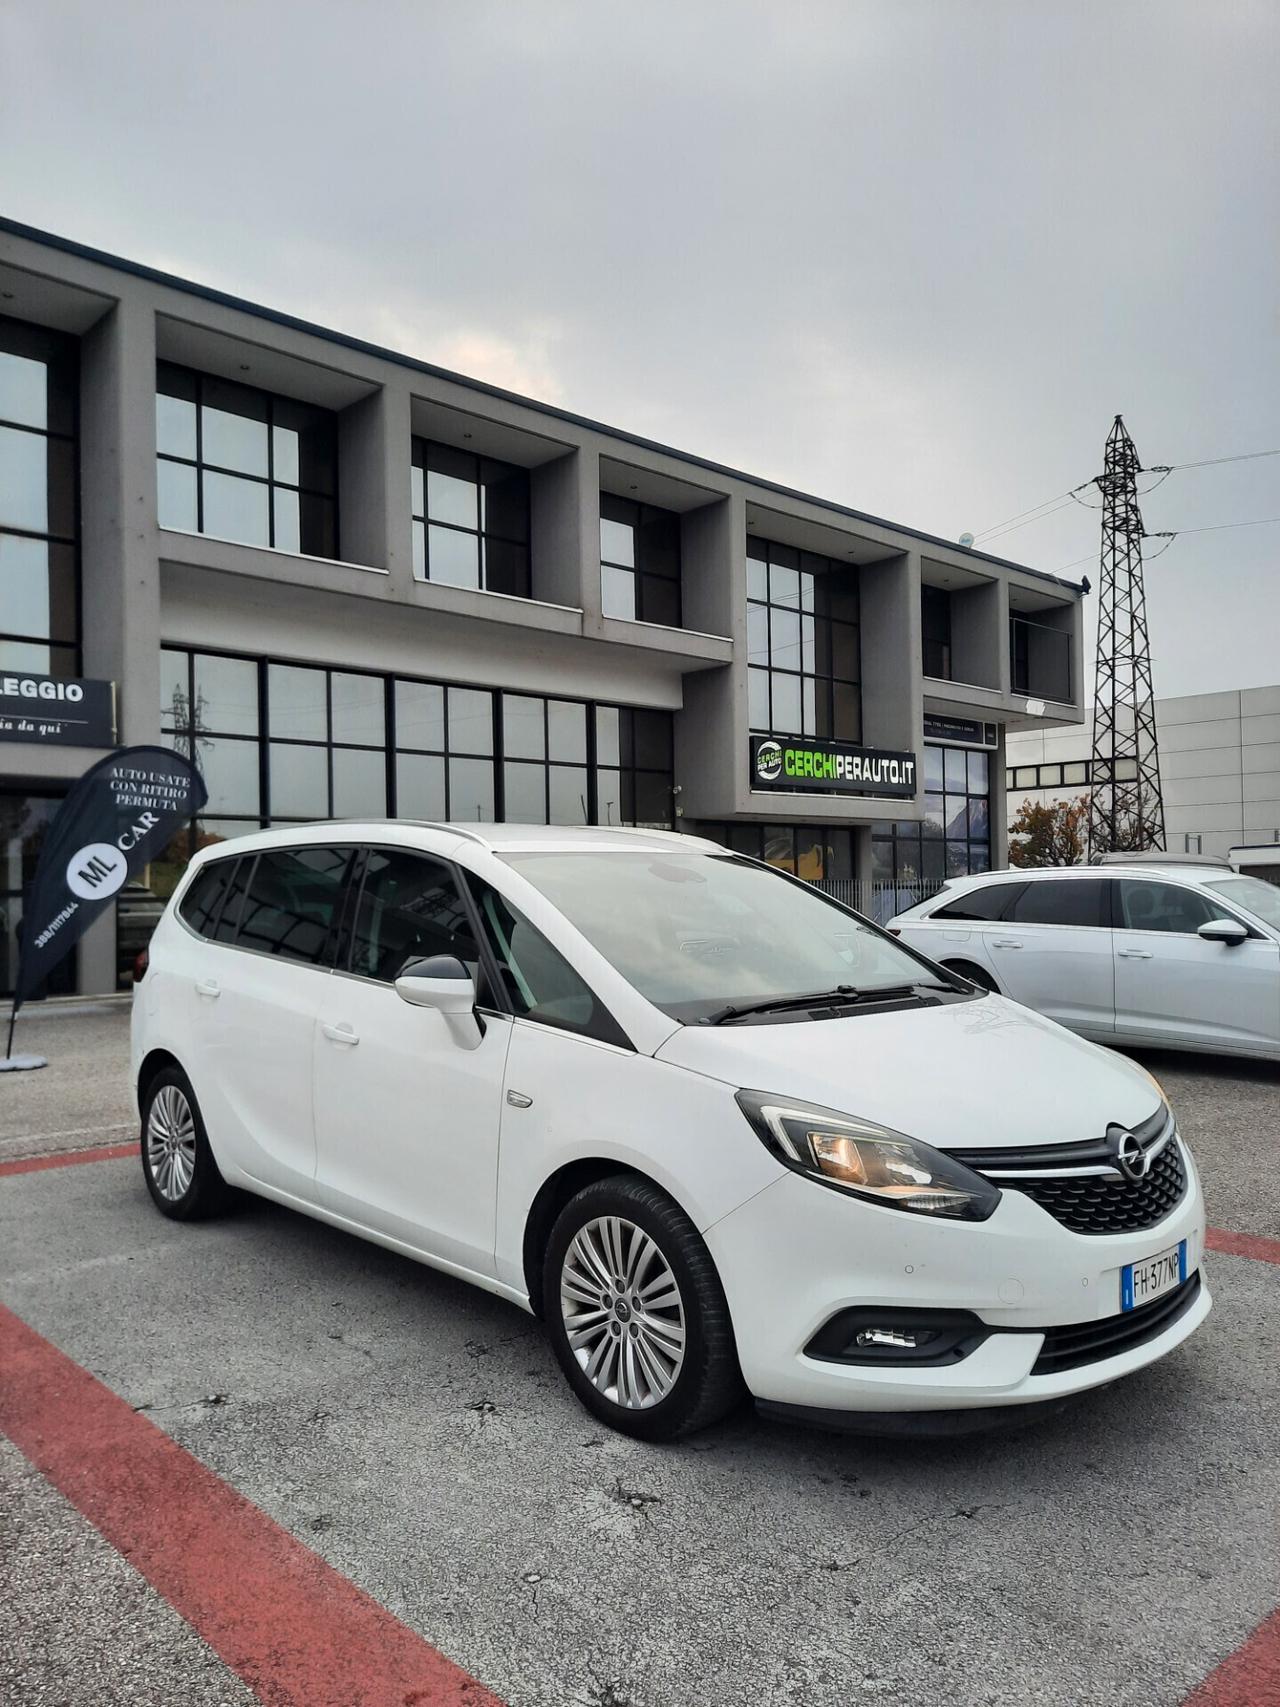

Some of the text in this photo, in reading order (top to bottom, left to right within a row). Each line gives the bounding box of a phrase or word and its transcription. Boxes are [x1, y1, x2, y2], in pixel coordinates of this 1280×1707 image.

[0, 678, 83, 702] EGGIO
[18, 720, 34, 731] da
[39, 723, 62, 736] qui
[111, 767, 191, 788] AUTO USATE
[785, 749, 914, 785] CERCHIPERAUTO.IT
[110, 780, 187, 799] CON RITIRO
[116, 793, 177, 811] PERMUTA
[77, 811, 160, 888] ML CAR
